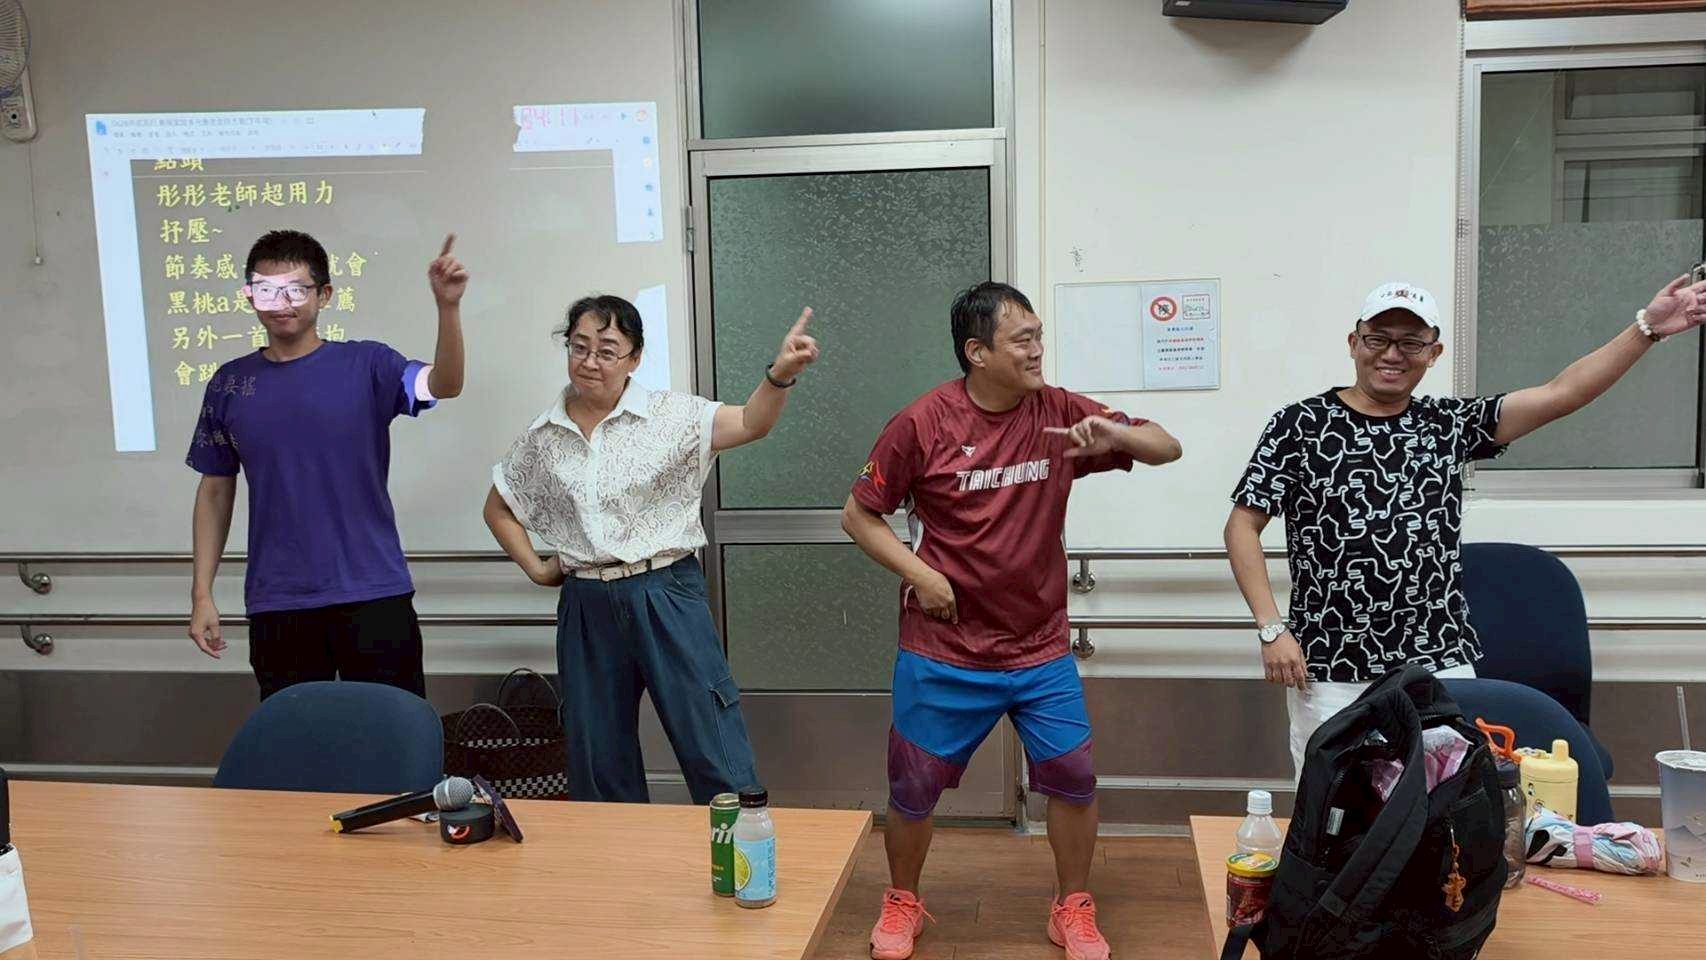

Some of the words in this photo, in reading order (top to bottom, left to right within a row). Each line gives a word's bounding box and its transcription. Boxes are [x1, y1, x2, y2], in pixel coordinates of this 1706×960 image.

[156, 180, 334, 208] 彤彤老師超用力
[956, 458, 1050, 492] TAICHUNG
